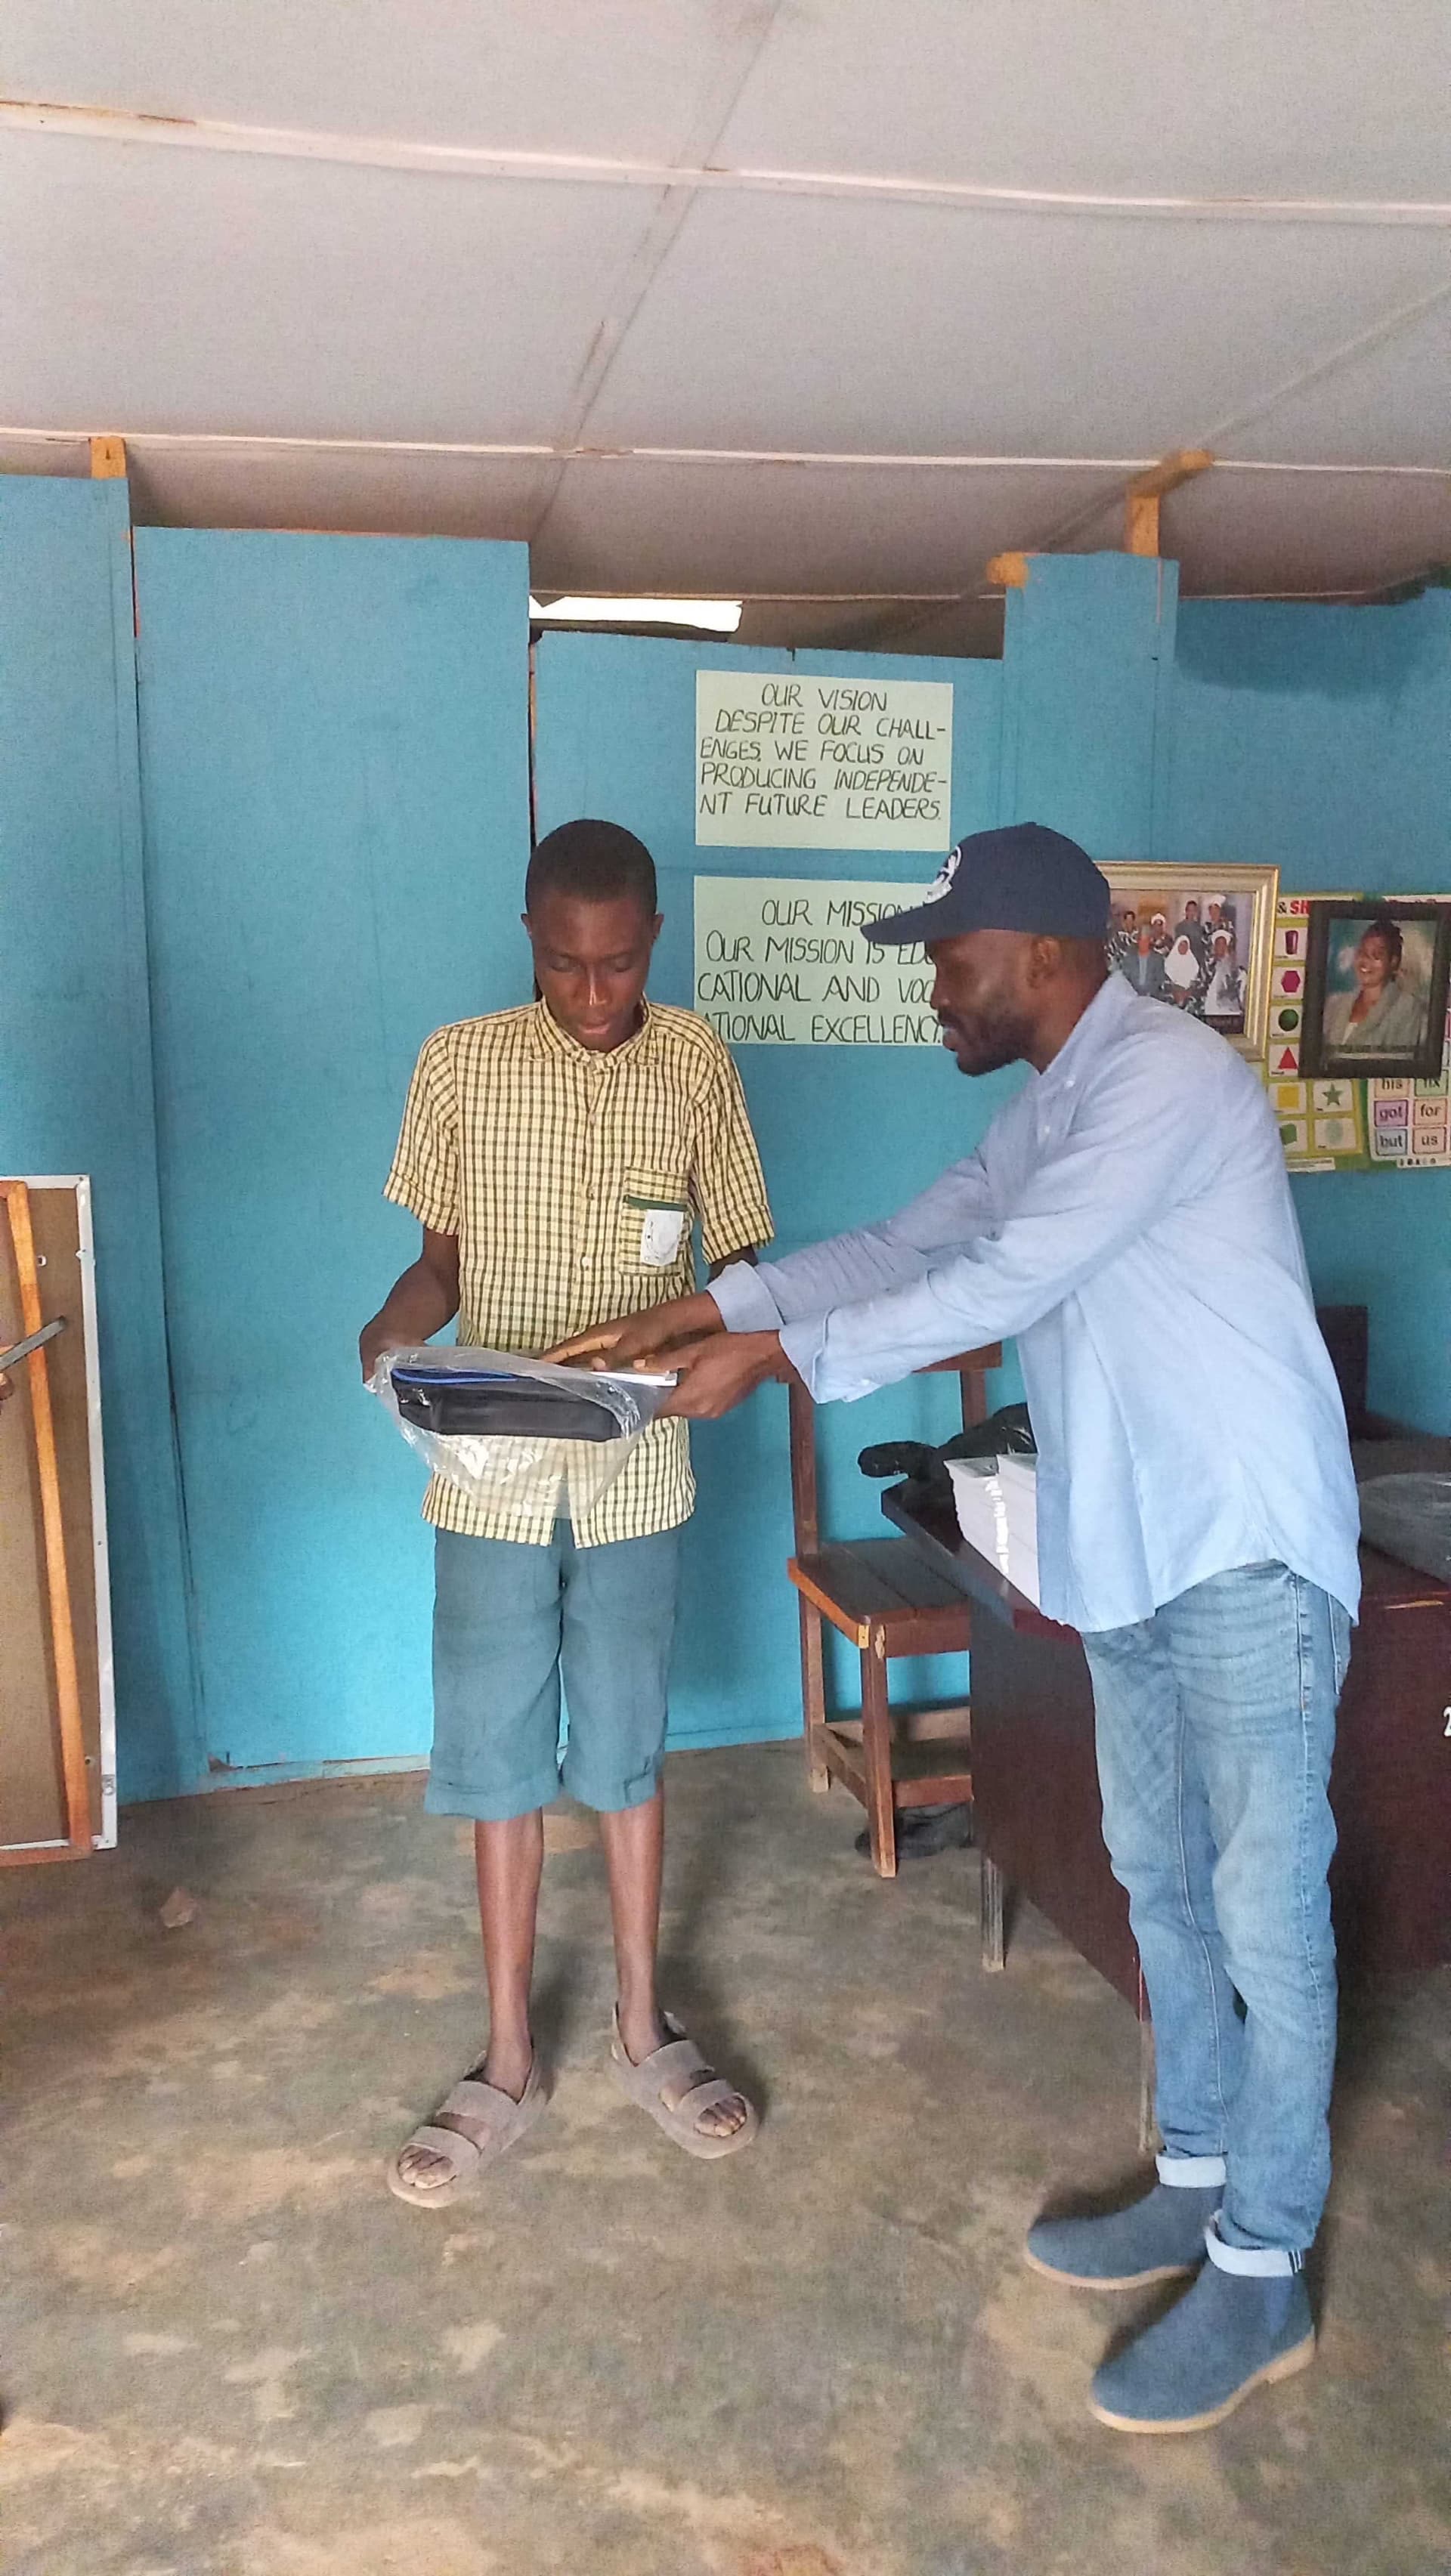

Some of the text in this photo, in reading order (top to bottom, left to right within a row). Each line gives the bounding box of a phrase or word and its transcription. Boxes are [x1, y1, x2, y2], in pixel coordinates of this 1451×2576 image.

[762, 683, 887, 712] OUR VISION
[716, 709, 947, 740] DESPITE OUR CHALL-
[774, 739, 809, 762] WE
[820, 740, 884, 765] FOCUS
[898, 746, 924, 765] ON
[701, 762, 948, 793] PRODUCING INDEPENDE-
[699, 791, 942, 821] NT FUTURE LEADERS.
[761, 899, 813, 926] OUR
[706, 929, 754, 962] OUR
[765, 936, 854, 963] MISSION
[866, 942, 884, 965] IS
[697, 970, 811, 1002] CATIONAL
[821, 975, 880, 1003] AND
[1379, 1106, 1403, 1122] got
[1421, 1104, 1441, 1117] for
[1380, 1135, 1403, 1147] but
[1422, 1136, 1439, 1146] us
